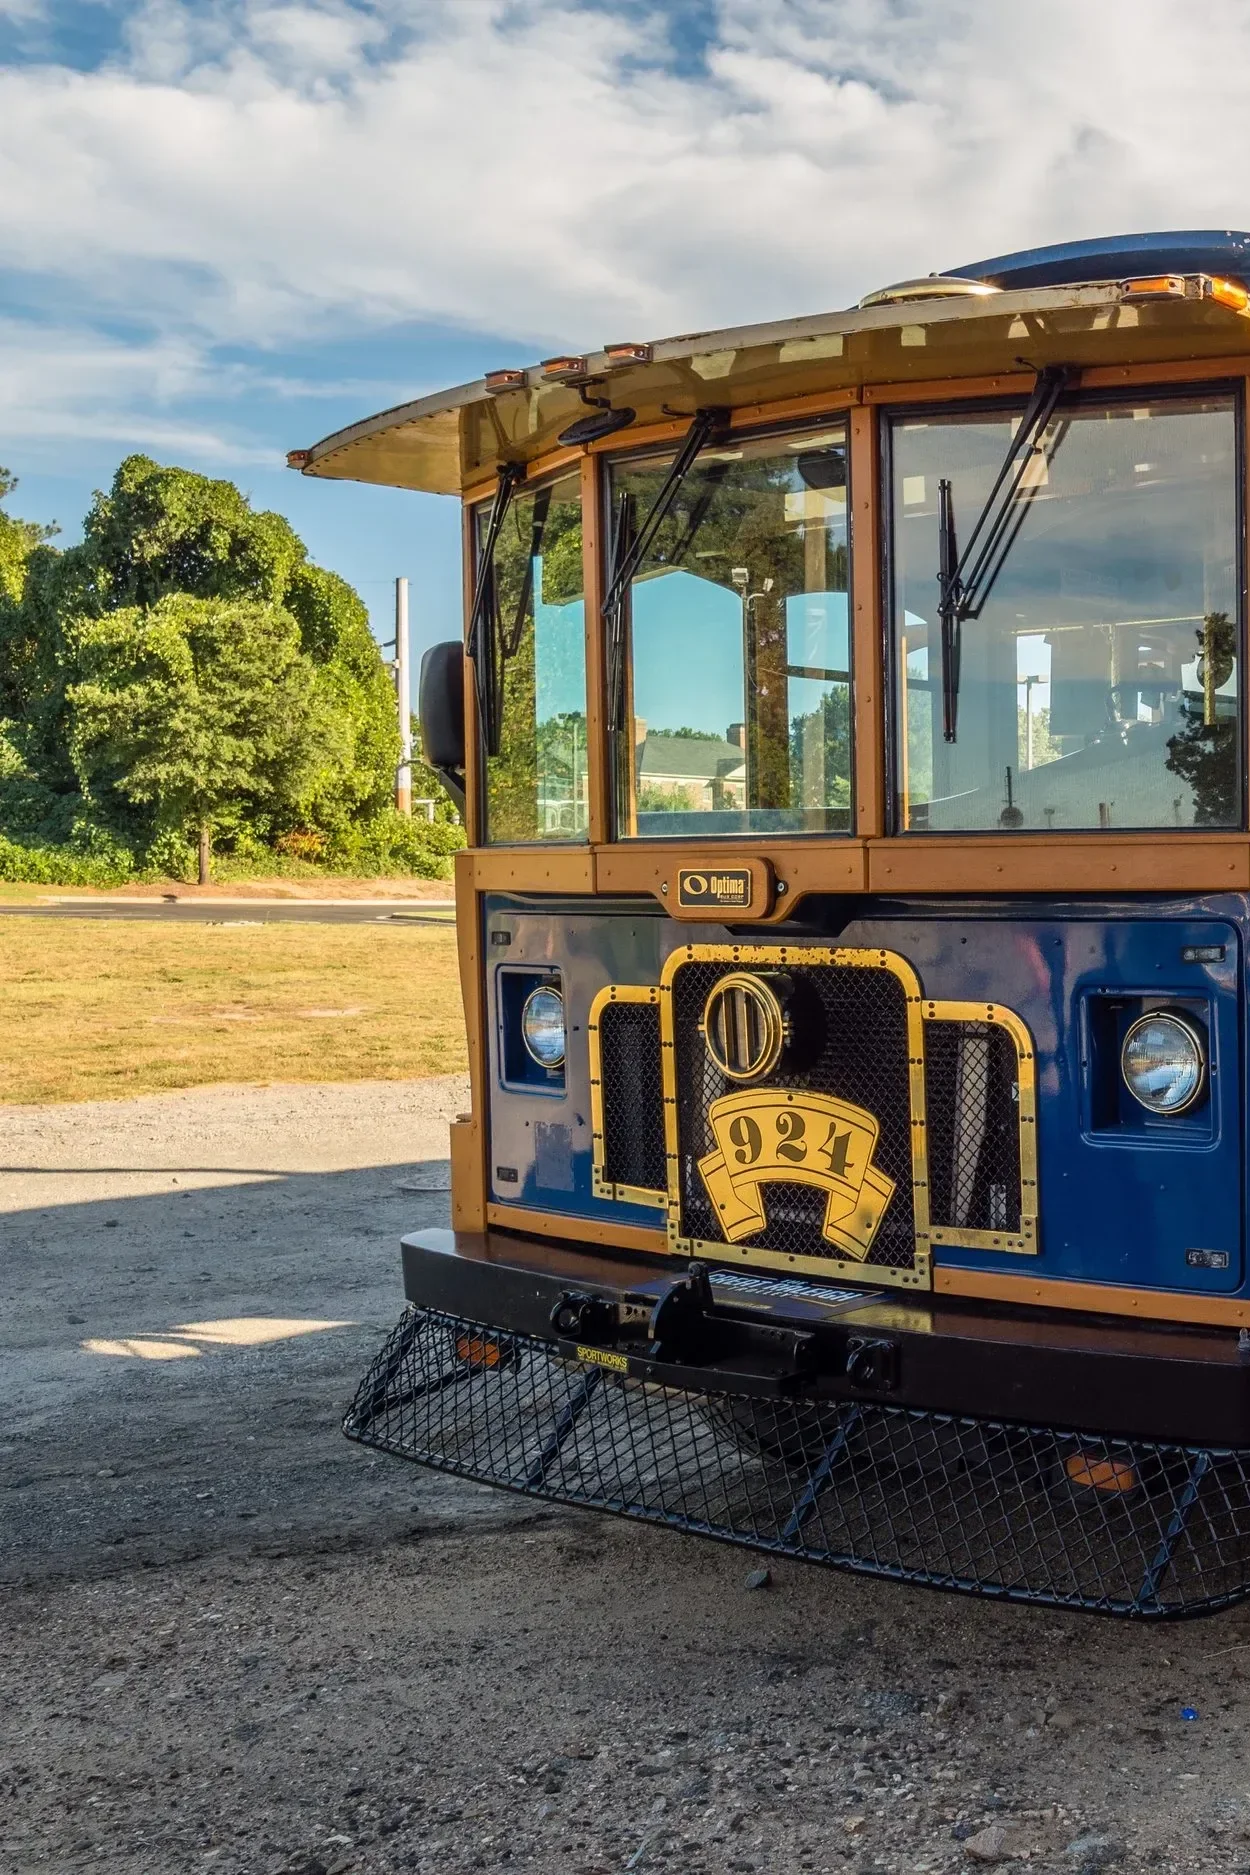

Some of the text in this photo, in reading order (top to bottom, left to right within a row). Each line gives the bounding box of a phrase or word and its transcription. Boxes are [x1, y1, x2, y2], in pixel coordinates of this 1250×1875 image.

[711, 876, 744, 898] Optima
[729, 1111, 855, 1179] 924
[763, 1283, 864, 1302] RALEIGH
[576, 1346, 628, 1368] SPORTWORKS
